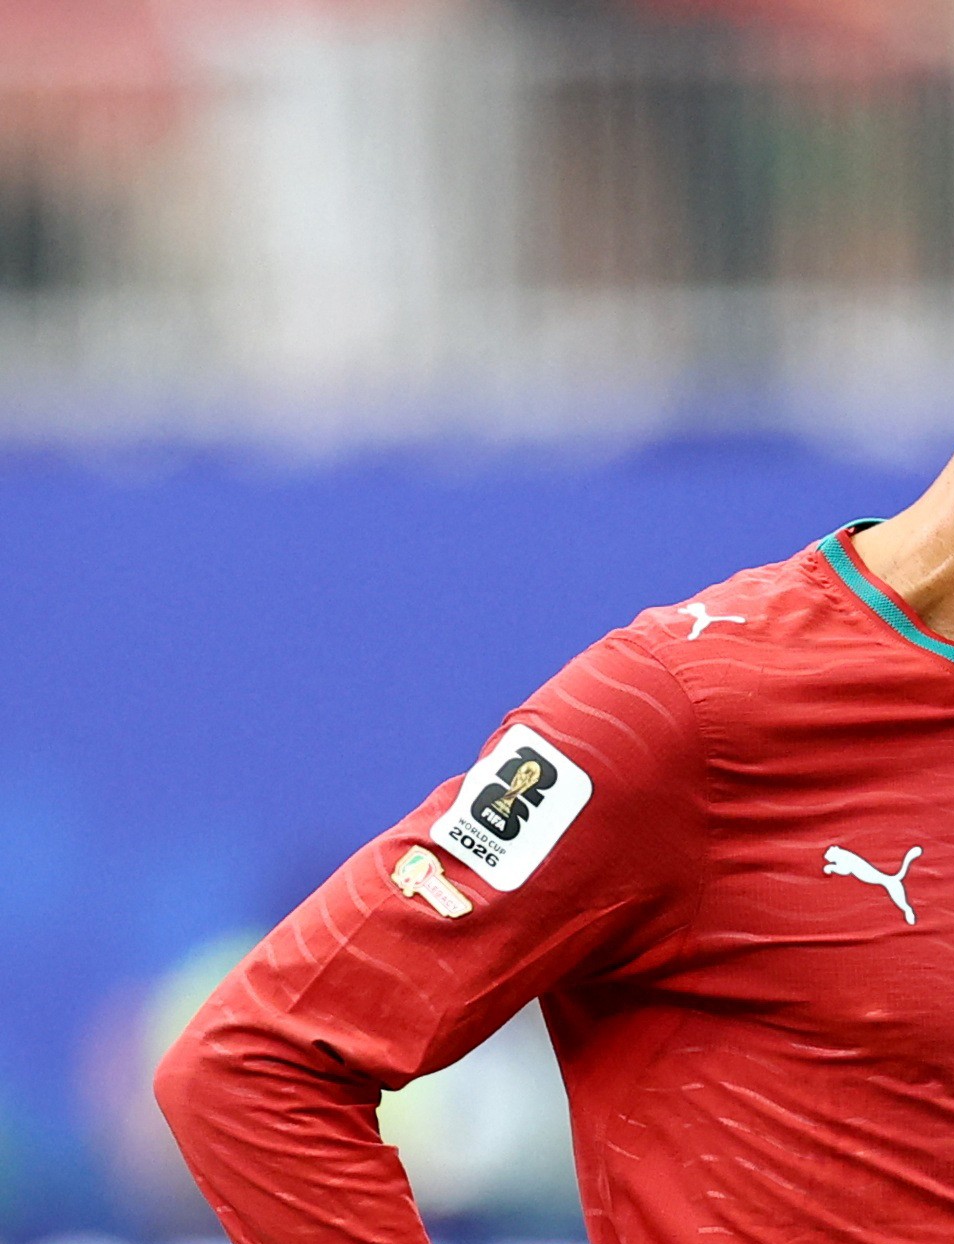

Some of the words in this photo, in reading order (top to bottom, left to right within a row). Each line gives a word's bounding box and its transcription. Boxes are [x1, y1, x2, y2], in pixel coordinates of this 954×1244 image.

[459, 818, 488, 842] WORLD
[488, 840, 507, 855] CUP
[480, 806, 507, 832] FIFA
[448, 826, 500, 867] 2026
